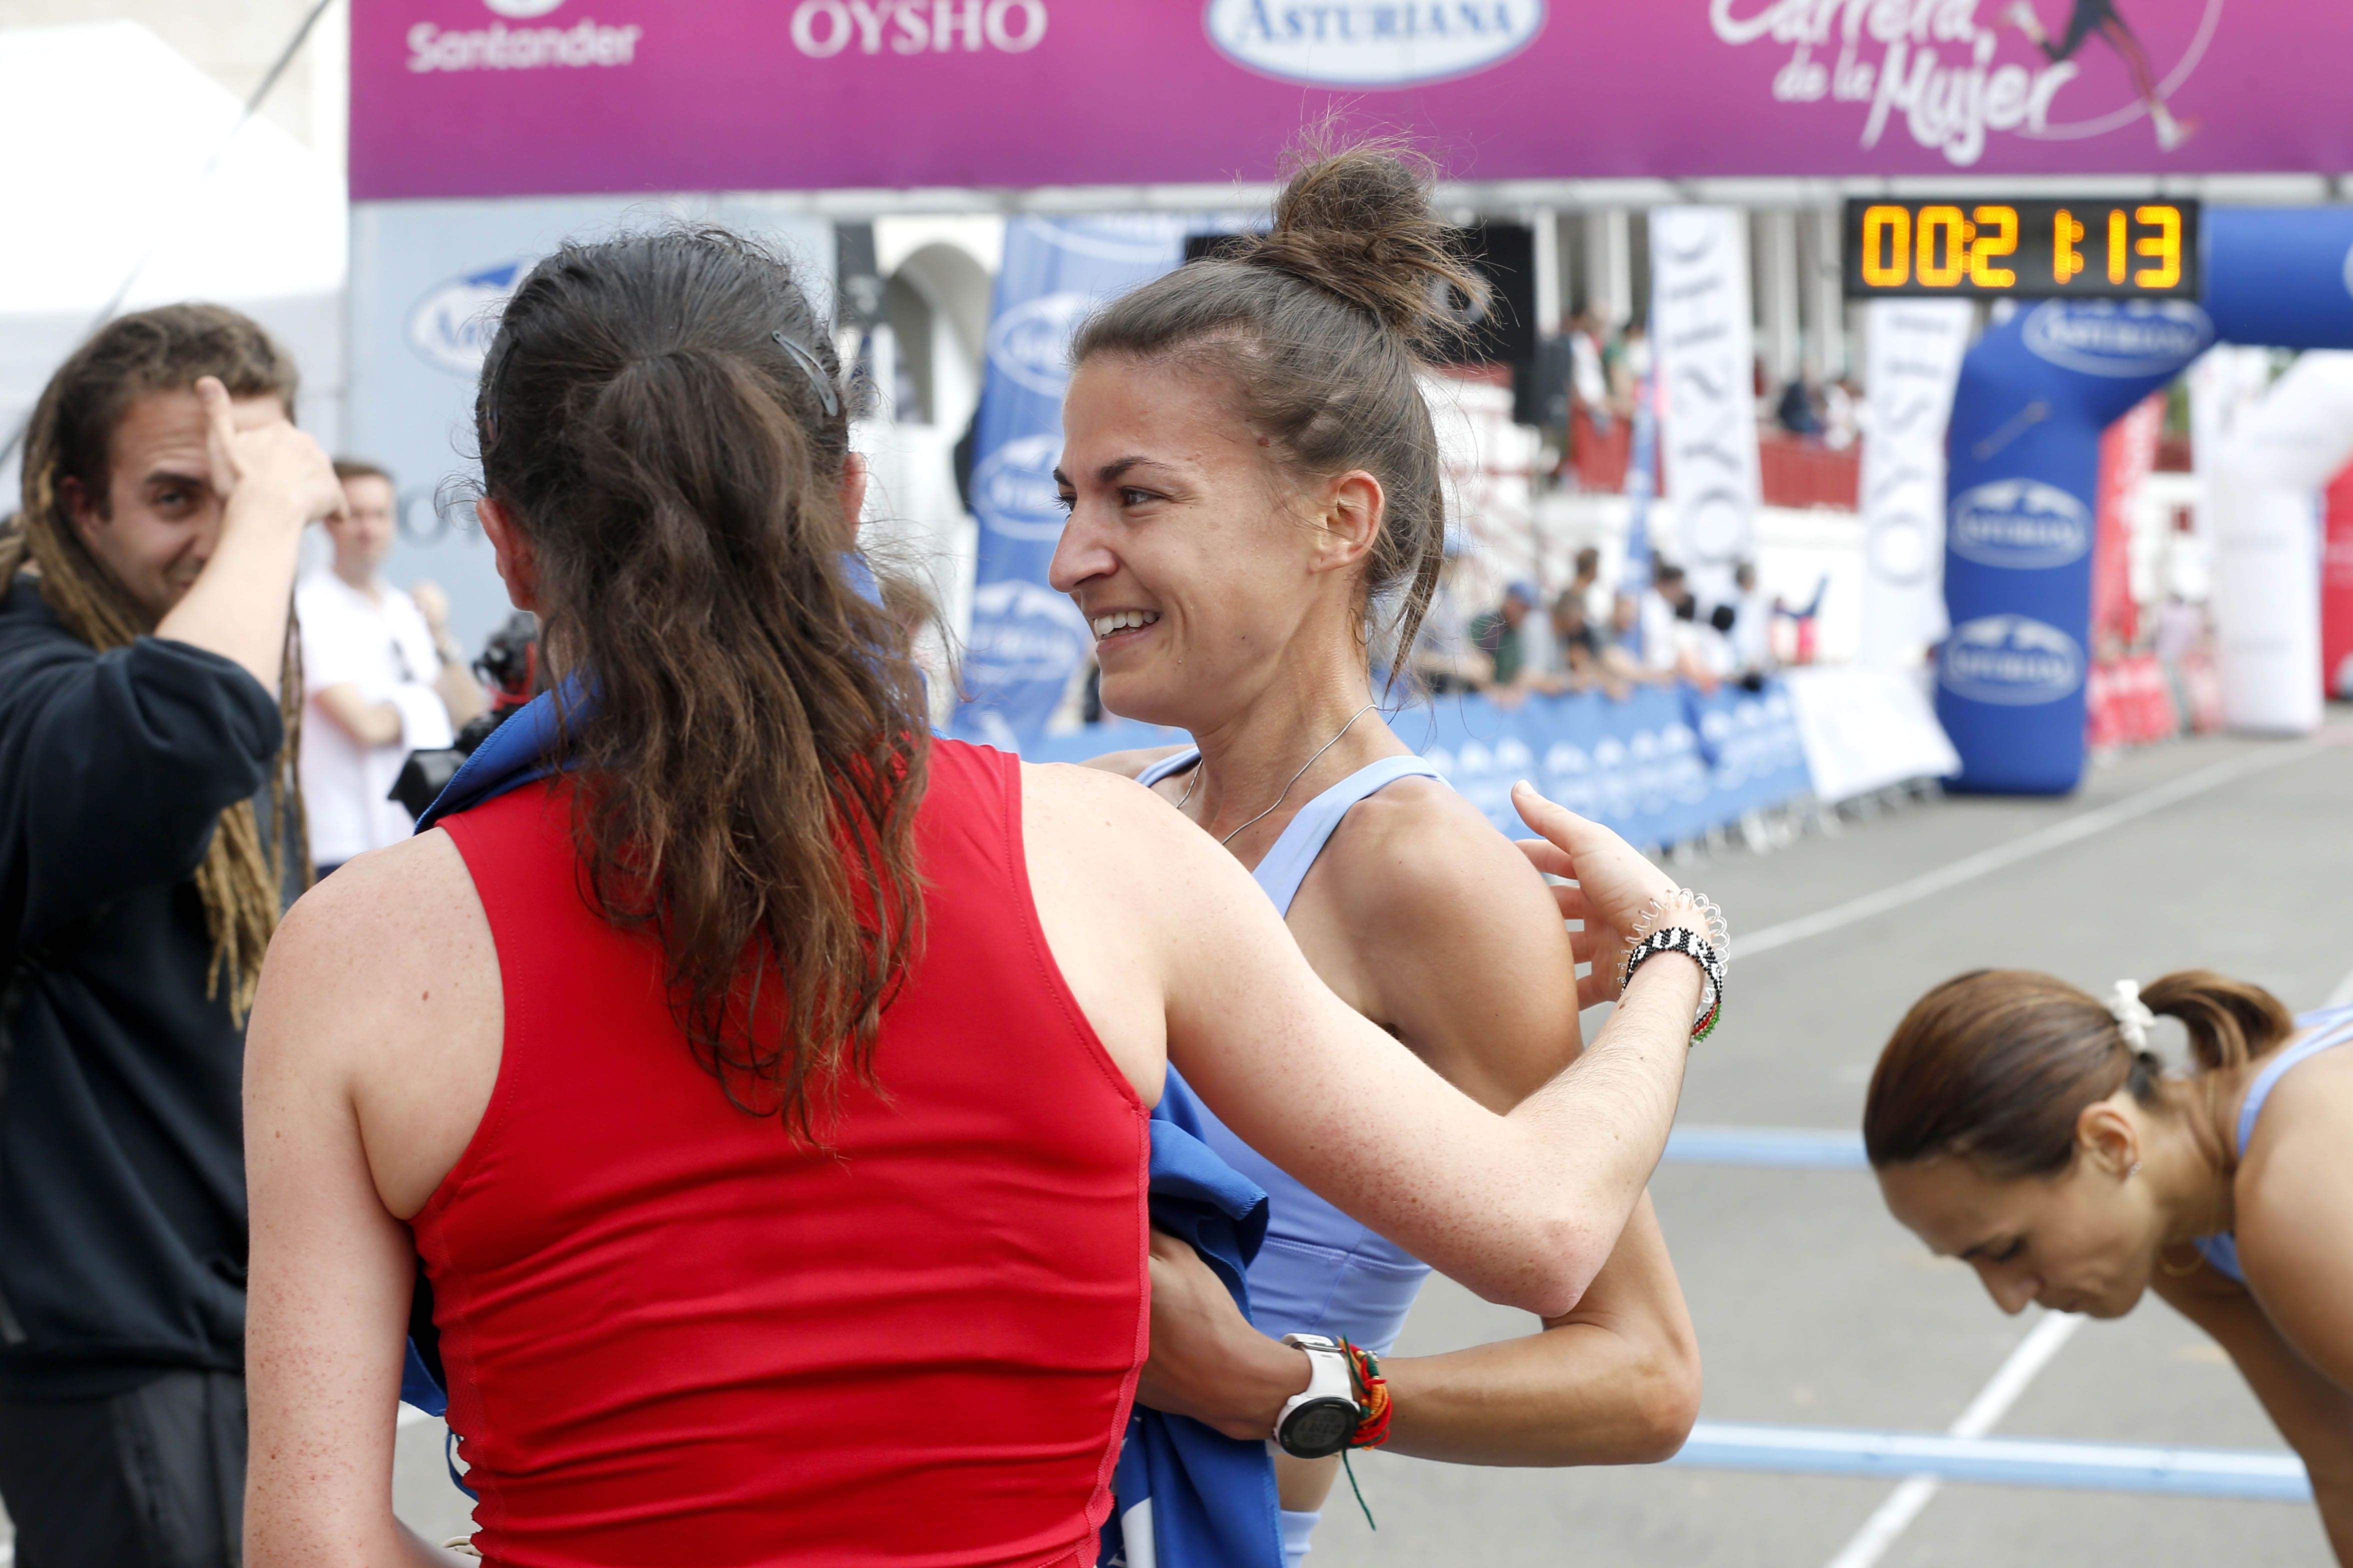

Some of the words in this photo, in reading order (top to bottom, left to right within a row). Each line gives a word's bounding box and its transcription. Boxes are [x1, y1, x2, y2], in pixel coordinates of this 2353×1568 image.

[407, 16, 642, 73] Santander
[791, 0, 1048, 58] OYSHO
[1773, 42, 1829, 102] de
[1831, 38, 1876, 102] la
[1858, 28, 2079, 166] Mujer
[1866, 312, 1951, 586] OYSH
